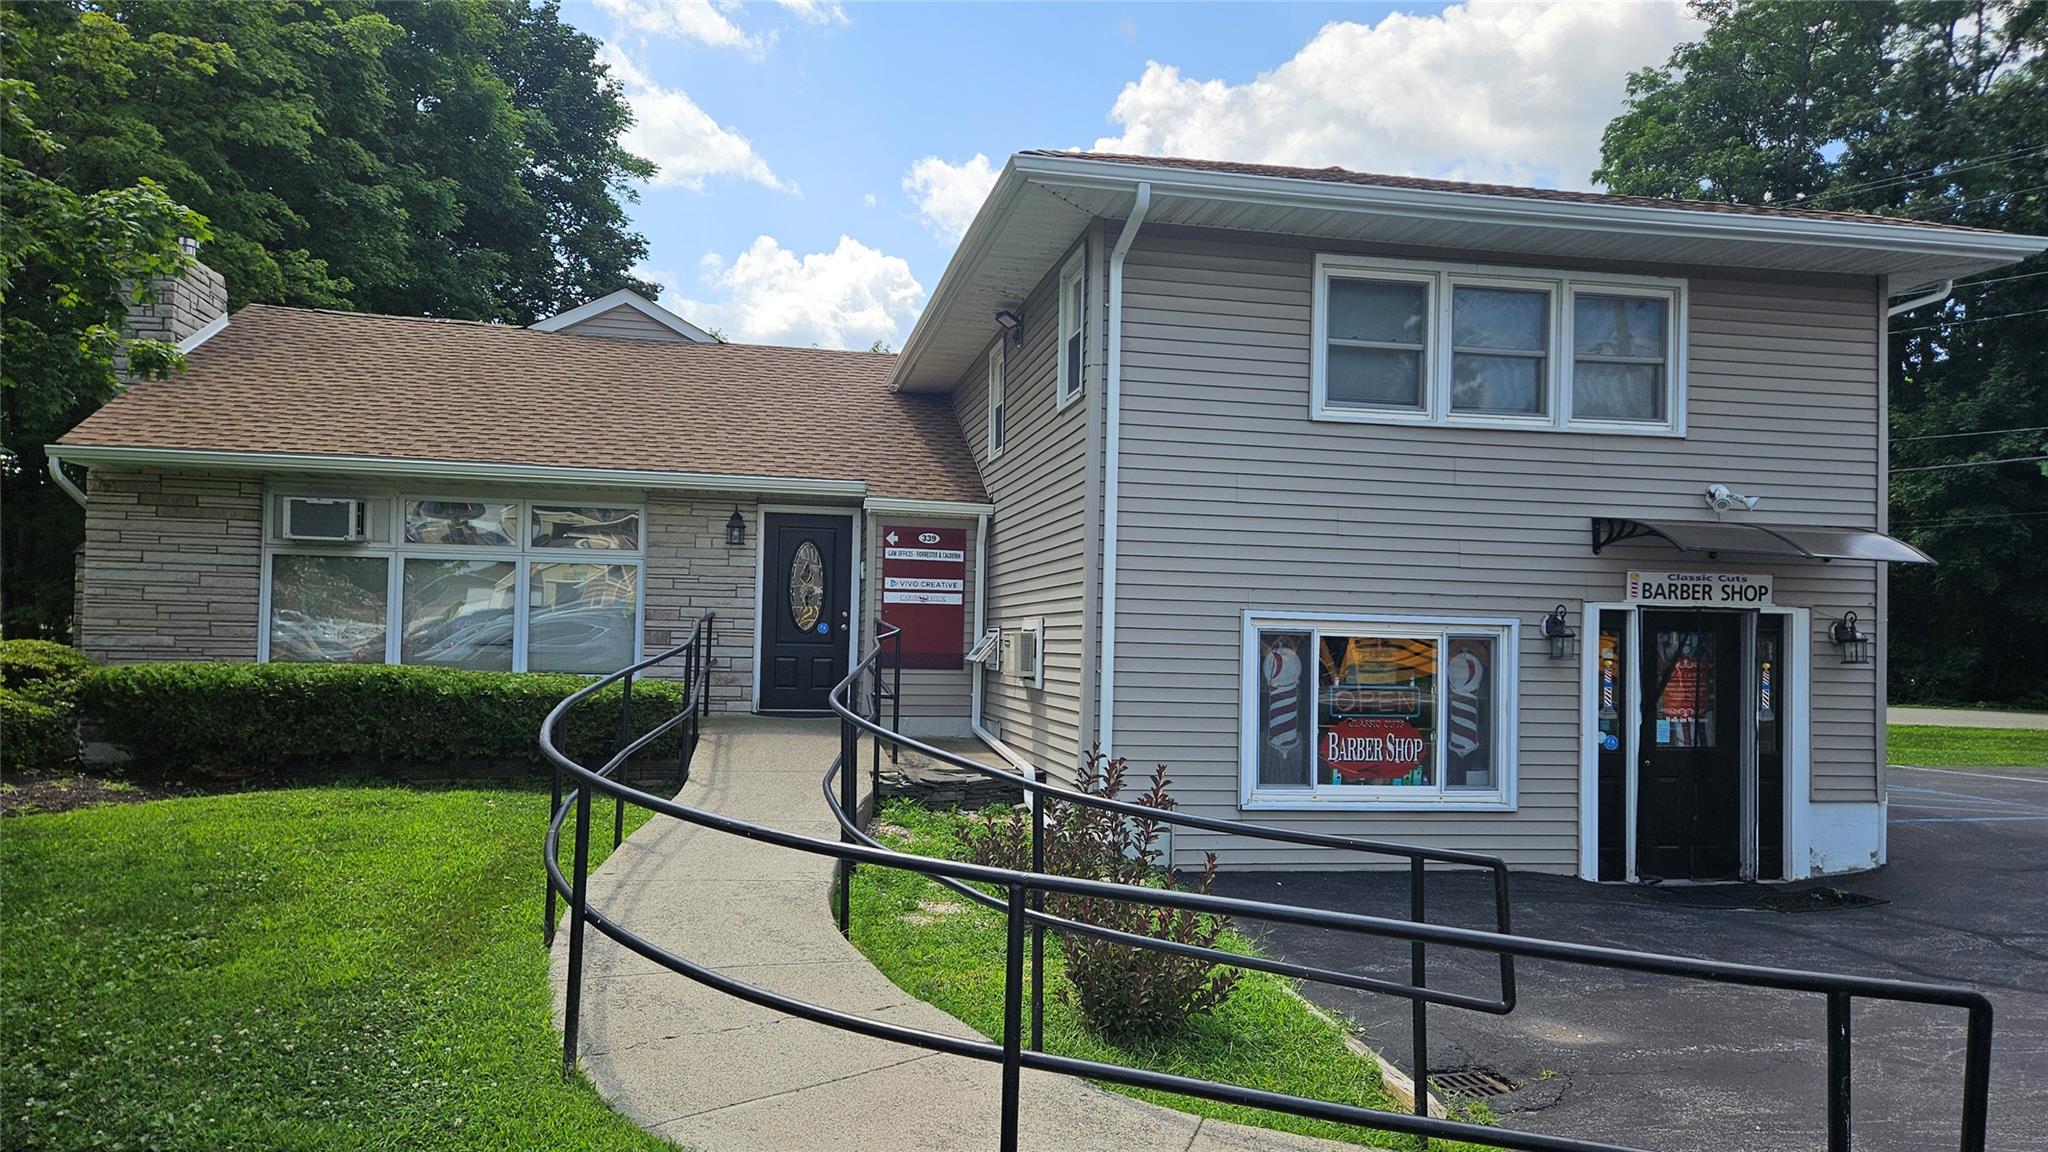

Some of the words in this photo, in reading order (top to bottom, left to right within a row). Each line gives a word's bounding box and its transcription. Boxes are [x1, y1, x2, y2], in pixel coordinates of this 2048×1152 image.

[921, 534, 937, 542] 339
[1667, 573, 1712, 582] Classic
[1718, 574, 1748, 583] Cuts
[1642, 582, 1713, 601] BARBER
[1721, 584, 1769, 602] SHOP
[1335, 691, 1416, 713] OPEN
[1327, 732, 1383, 762] BARBER
[1385, 732, 1424, 763] SHOP
